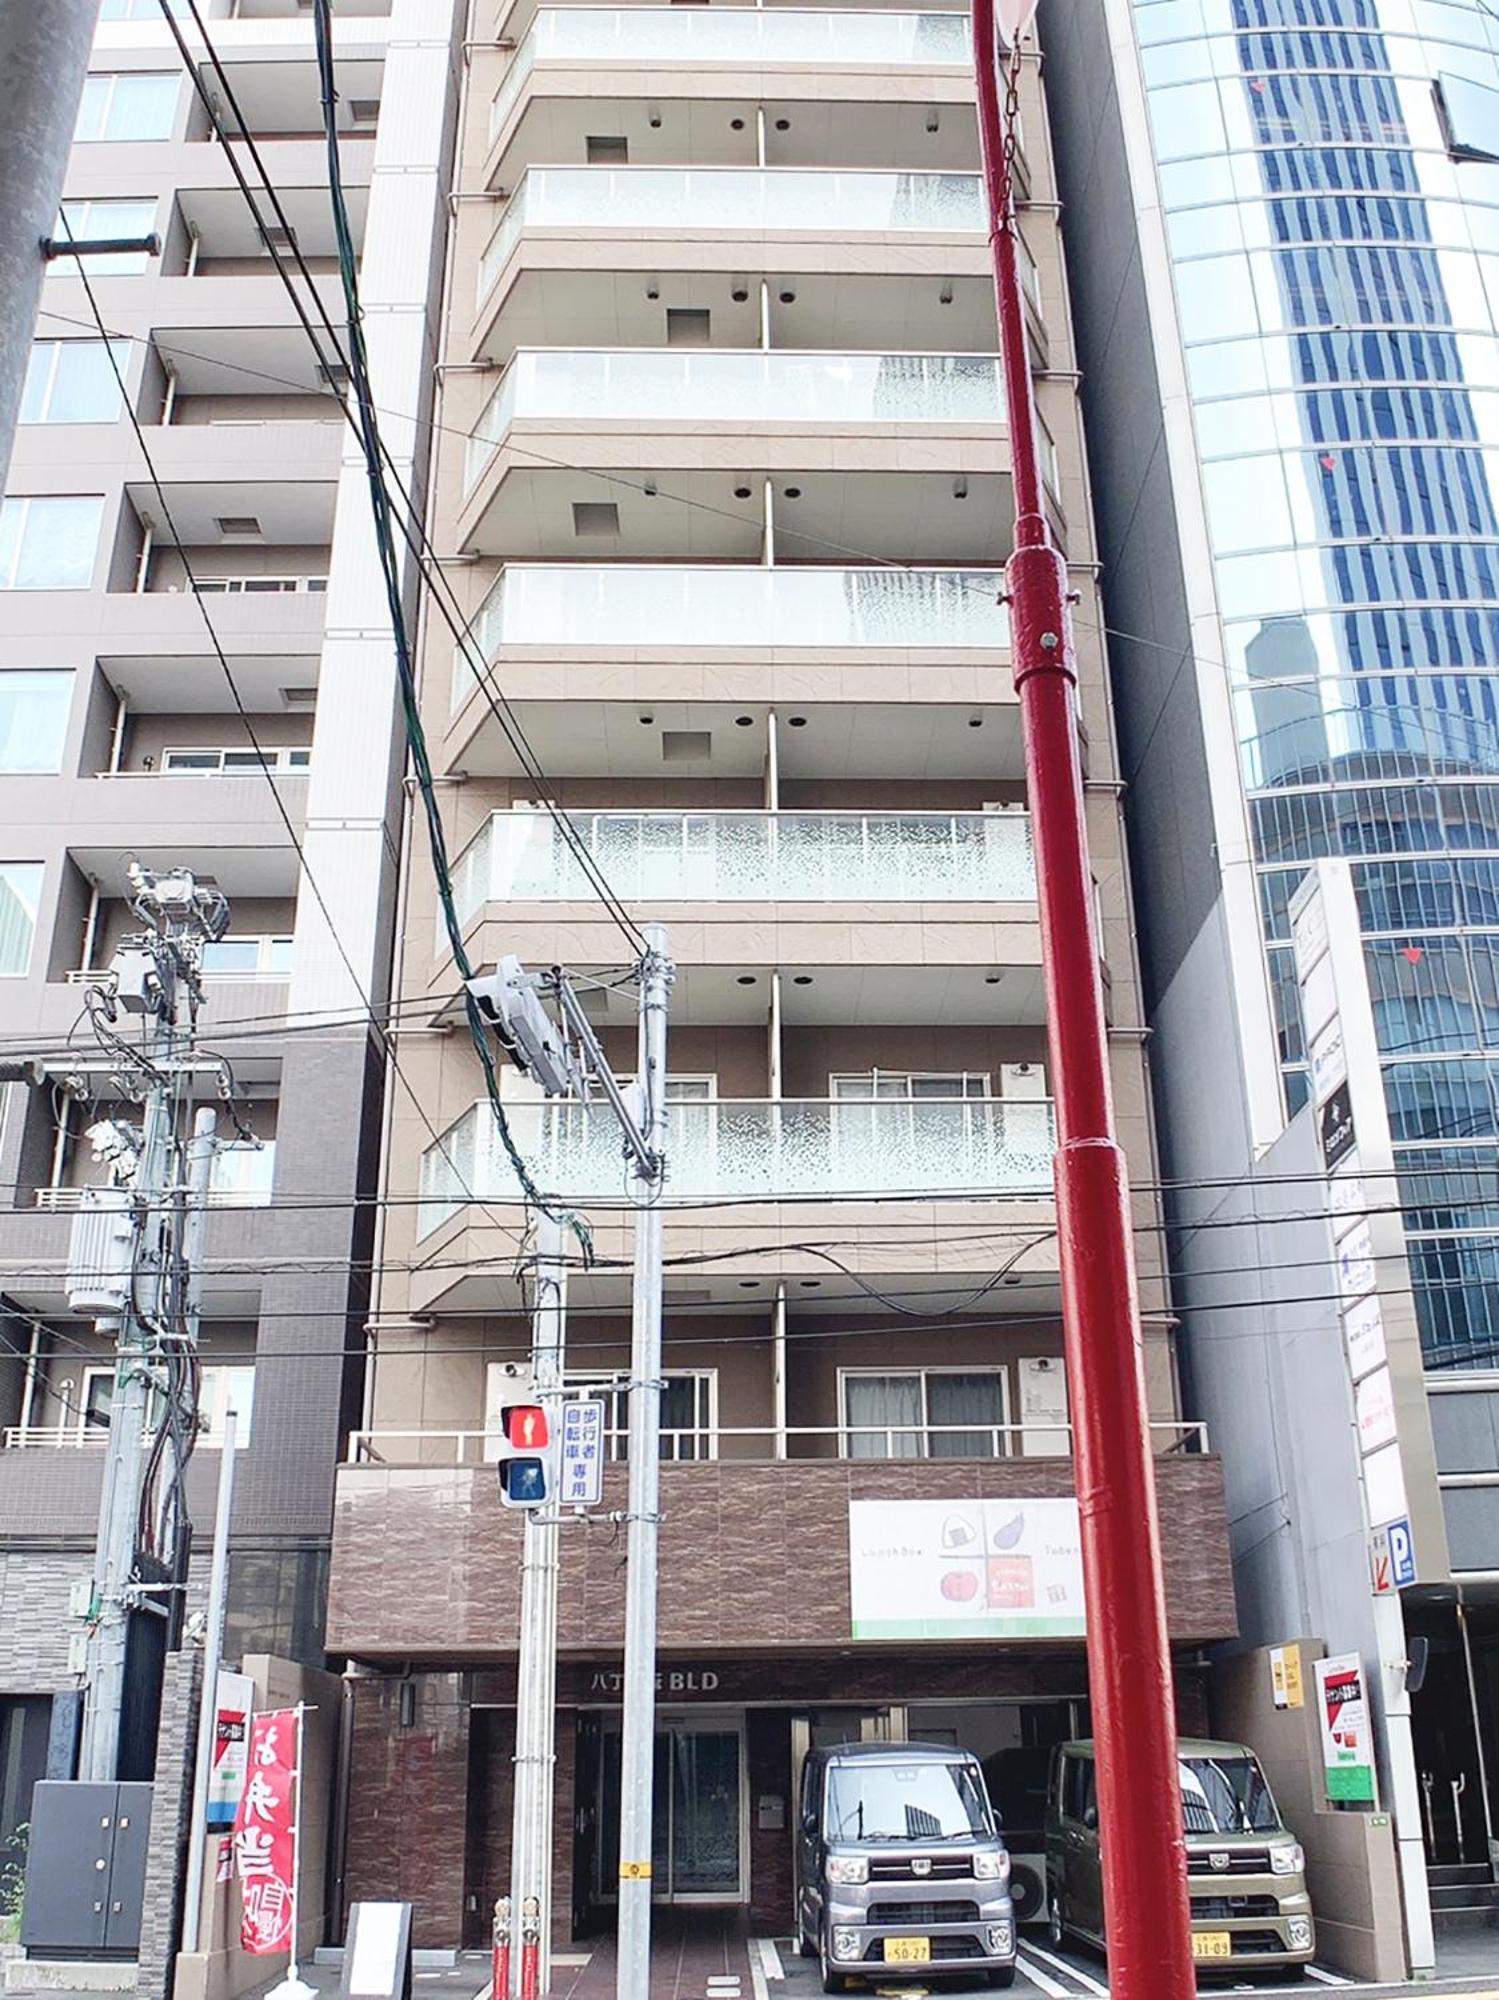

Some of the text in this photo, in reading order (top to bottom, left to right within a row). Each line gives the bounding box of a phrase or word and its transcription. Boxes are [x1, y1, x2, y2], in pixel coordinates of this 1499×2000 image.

[582, 1408, 598, 1460] 歩行者
[571, 1463, 588, 1497] 専用
[1390, 1526, 1409, 1582] P
[669, 1672, 719, 1691] BLD
[893, 1946, 927, 1960] 50-27
